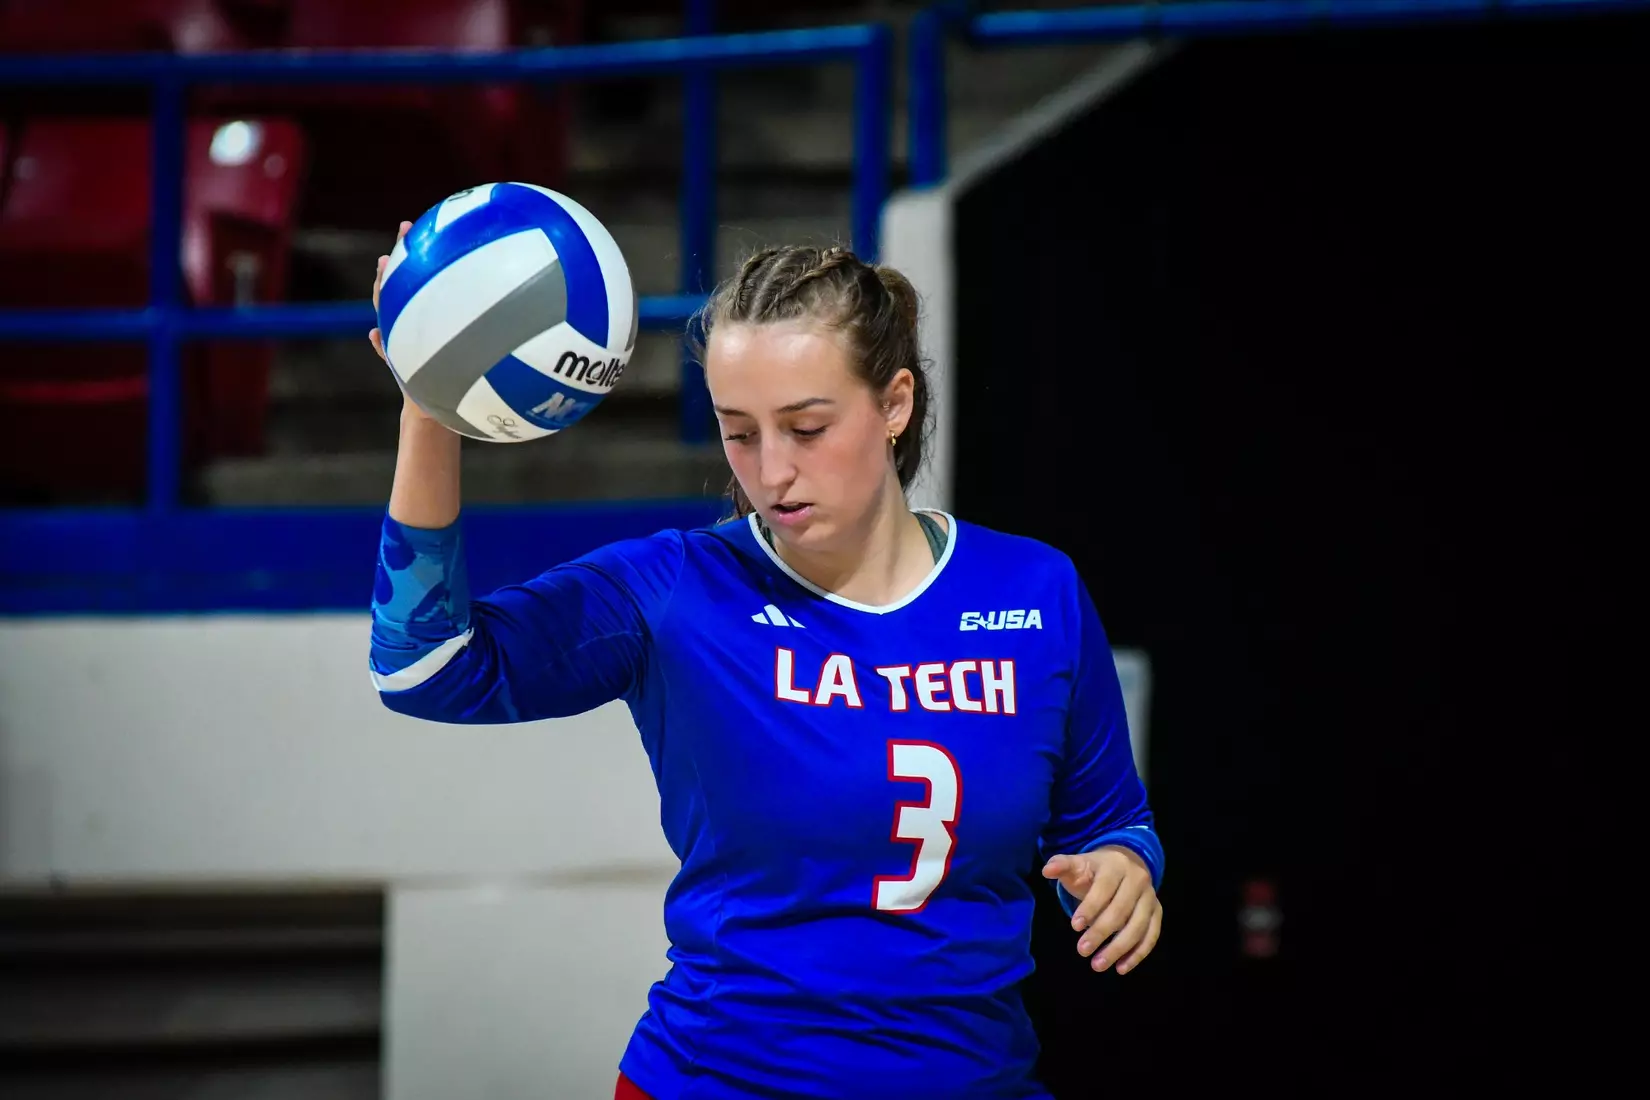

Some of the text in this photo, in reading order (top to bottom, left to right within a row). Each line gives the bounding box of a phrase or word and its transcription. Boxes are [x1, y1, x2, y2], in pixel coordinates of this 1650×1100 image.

[775, 647, 1016, 715] LA TECH
[871, 739, 963, 913] 3
